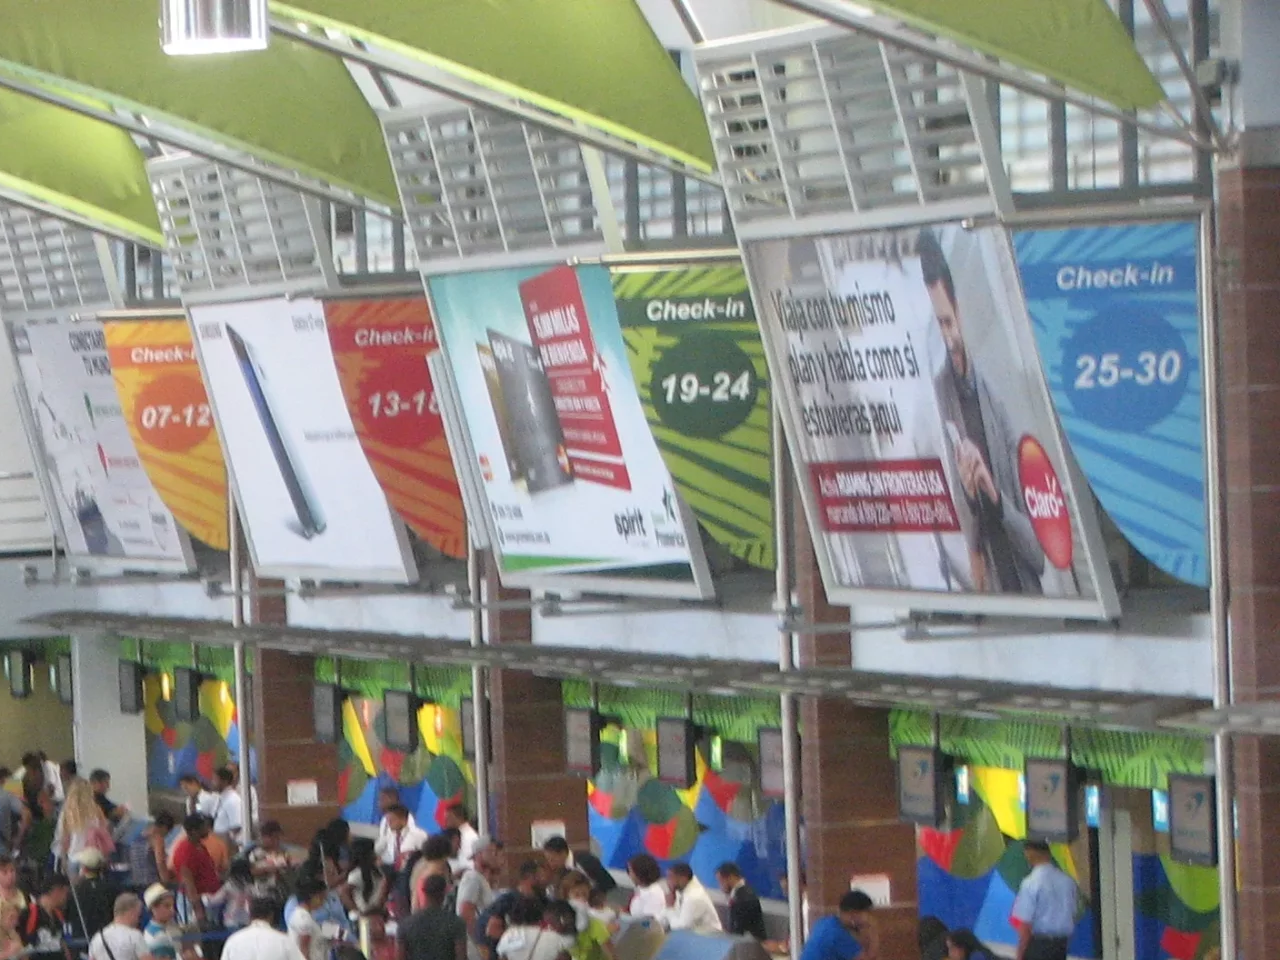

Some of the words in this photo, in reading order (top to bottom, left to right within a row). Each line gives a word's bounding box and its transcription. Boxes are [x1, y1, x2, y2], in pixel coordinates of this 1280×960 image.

[1056, 261, 1174, 290] Check-in
[646, 297, 745, 321] Check-in
[770, 288, 808, 344] Viaja
[807, 296, 833, 331] con
[828, 289, 848, 328] tu
[846, 281, 895, 331] mismo
[131, 345, 196, 363] Check-i
[788, 343, 820, 396] plan
[823, 341, 867, 383] habla
[865, 344, 906, 382] como
[903, 330, 920, 378] si
[1074, 350, 1181, 389] 25-30
[662, 370, 750, 404] 19-24
[142, 403, 211, 429] 07-12
[802, 393, 871, 438] estuvieras
[1024, 480, 1061, 519] Claro
[614, 507, 647, 543] spirit
